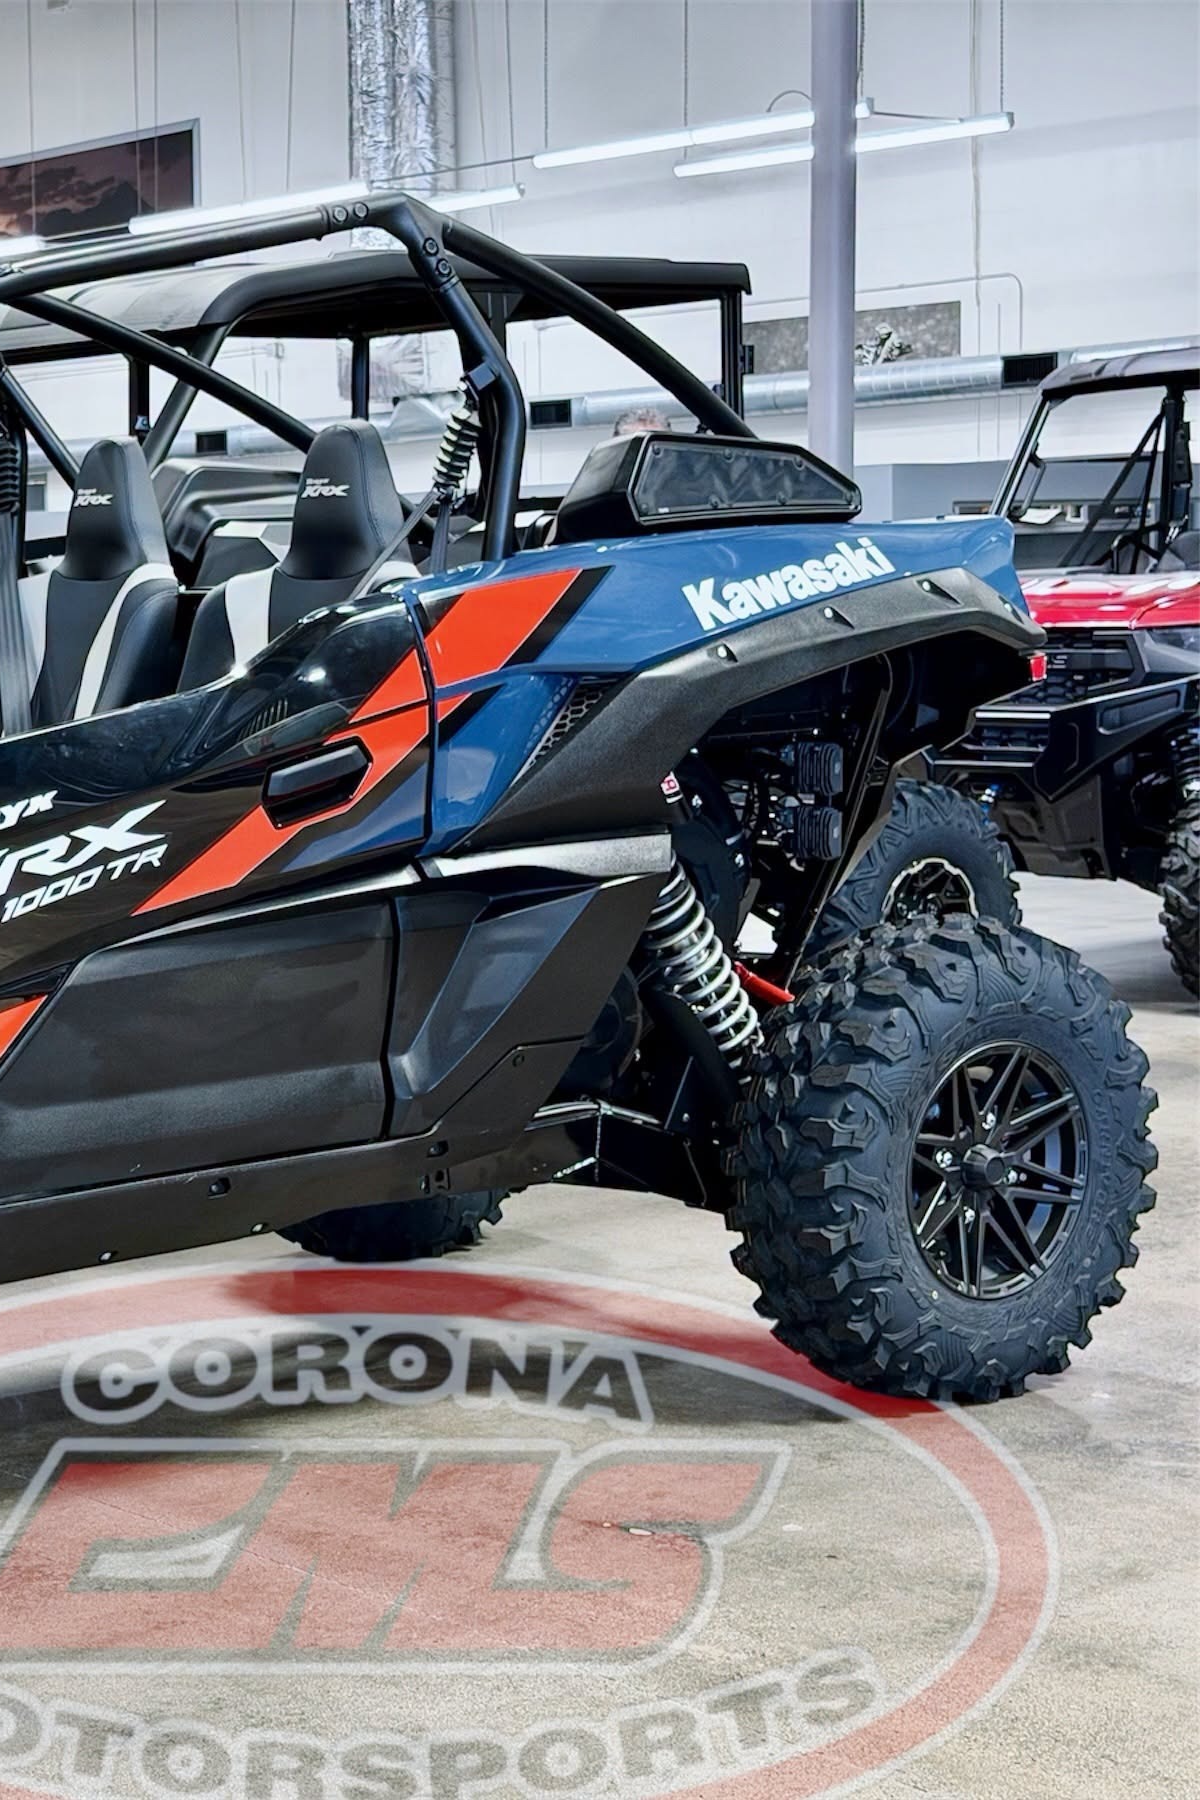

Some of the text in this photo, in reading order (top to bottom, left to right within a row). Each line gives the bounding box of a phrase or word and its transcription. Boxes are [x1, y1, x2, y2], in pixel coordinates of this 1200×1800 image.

[681, 536, 897, 632] Kawasaki
[1, 843, 169, 924] 1000 TR
[80, 1331, 642, 1421] CORONA
